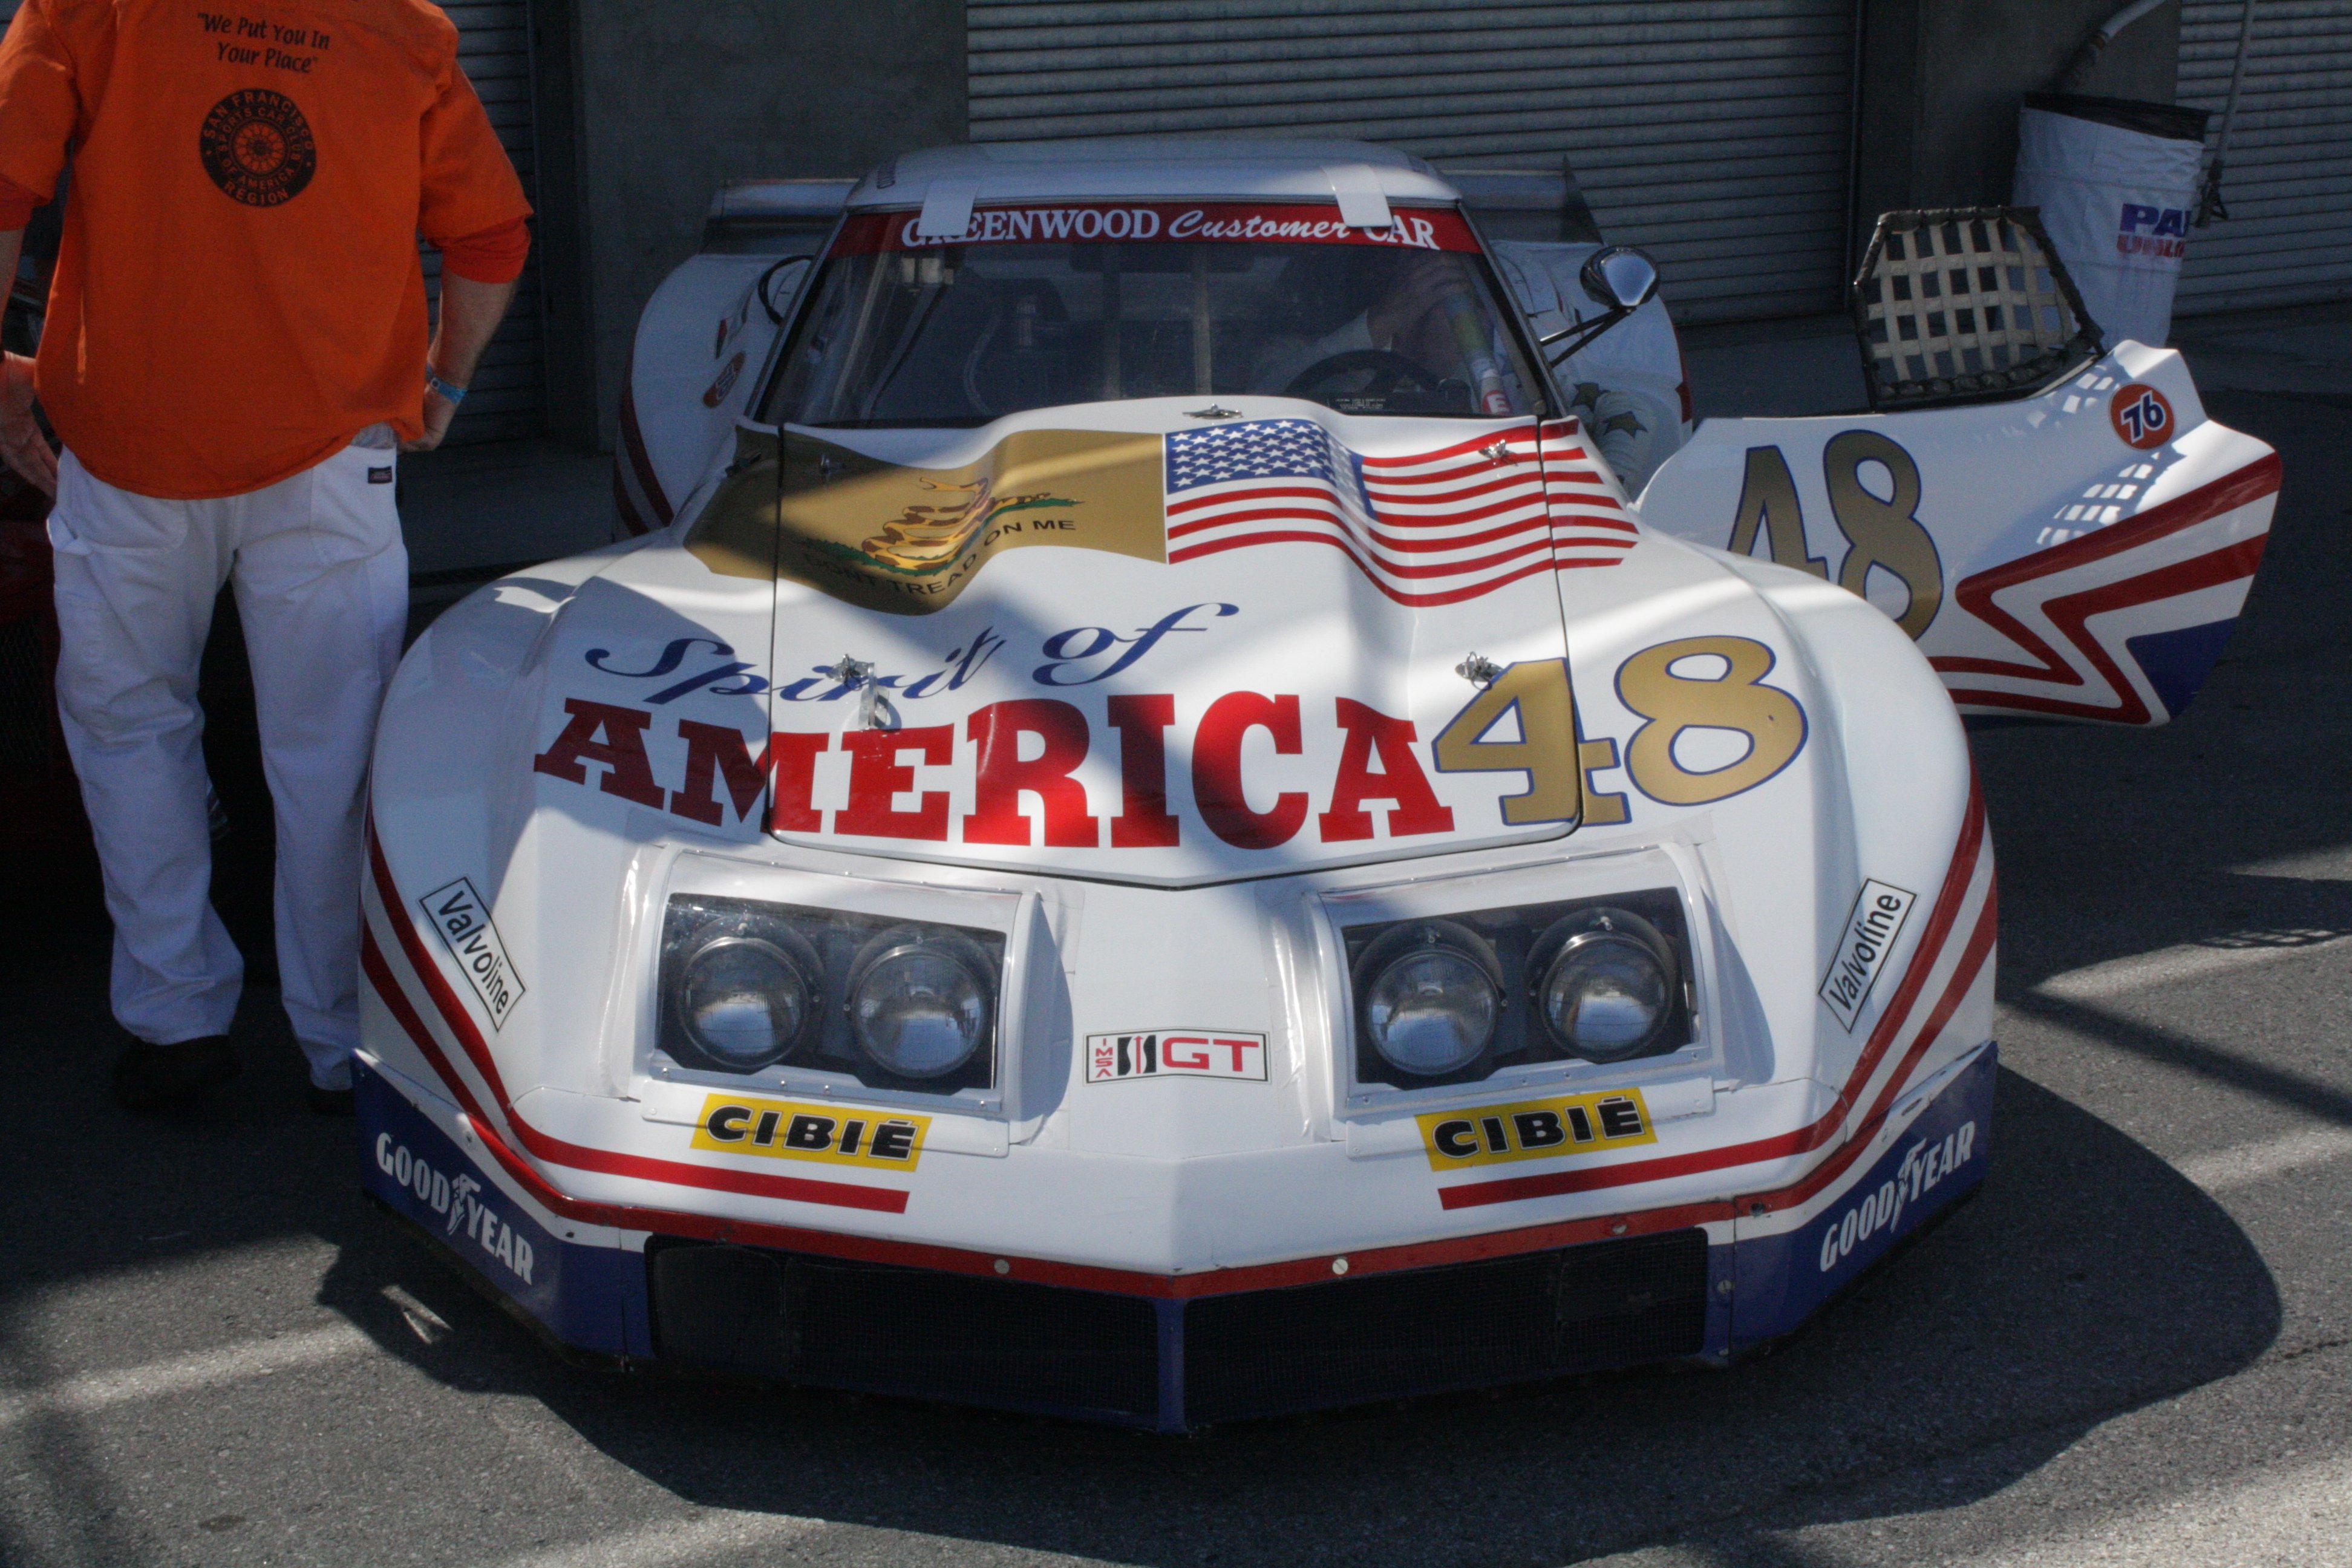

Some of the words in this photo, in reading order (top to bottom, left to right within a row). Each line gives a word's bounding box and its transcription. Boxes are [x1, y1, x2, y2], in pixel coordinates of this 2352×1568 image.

[217, 42, 260, 65] Your
[237, 17, 267, 39] Put
[273, 24, 307, 45] You
[310, 30, 330, 50] In
[203, 104, 229, 137] SAN
[232, 91, 313, 150] FRANCISCO
[217, 107, 252, 151] SPORTS
[258, 107, 285, 122] CAR
[286, 126, 301, 160] CLUB
[222, 158, 238, 174] OF
[238, 168, 296, 191] AMERICA
[224, 181, 290, 204] REGION
[901, 209, 1160, 247] GEENWOOD
[1168, 210, 1350, 238] Customer
[2120, 389, 2167, 443] 76
[885, 553, 978, 595] TREAD
[984, 521, 1022, 546] ON
[1033, 520, 1076, 531] ME
[1728, 429, 1944, 642] 48
[585, 626, 1007, 705] Spirit
[1033, 603, 1240, 687] of
[1431, 635, 1809, 827] 48
[534, 690, 1455, 850] AMERICA
[438, 890, 509, 1014] Valvoline
[1828, 894, 1901, 1011] Valvoline
[1162, 1036, 1259, 1073] GT
[706, 1103, 920, 1161] CIBIÉ
[1432, 1095, 1645, 1159] CIBIÉ
